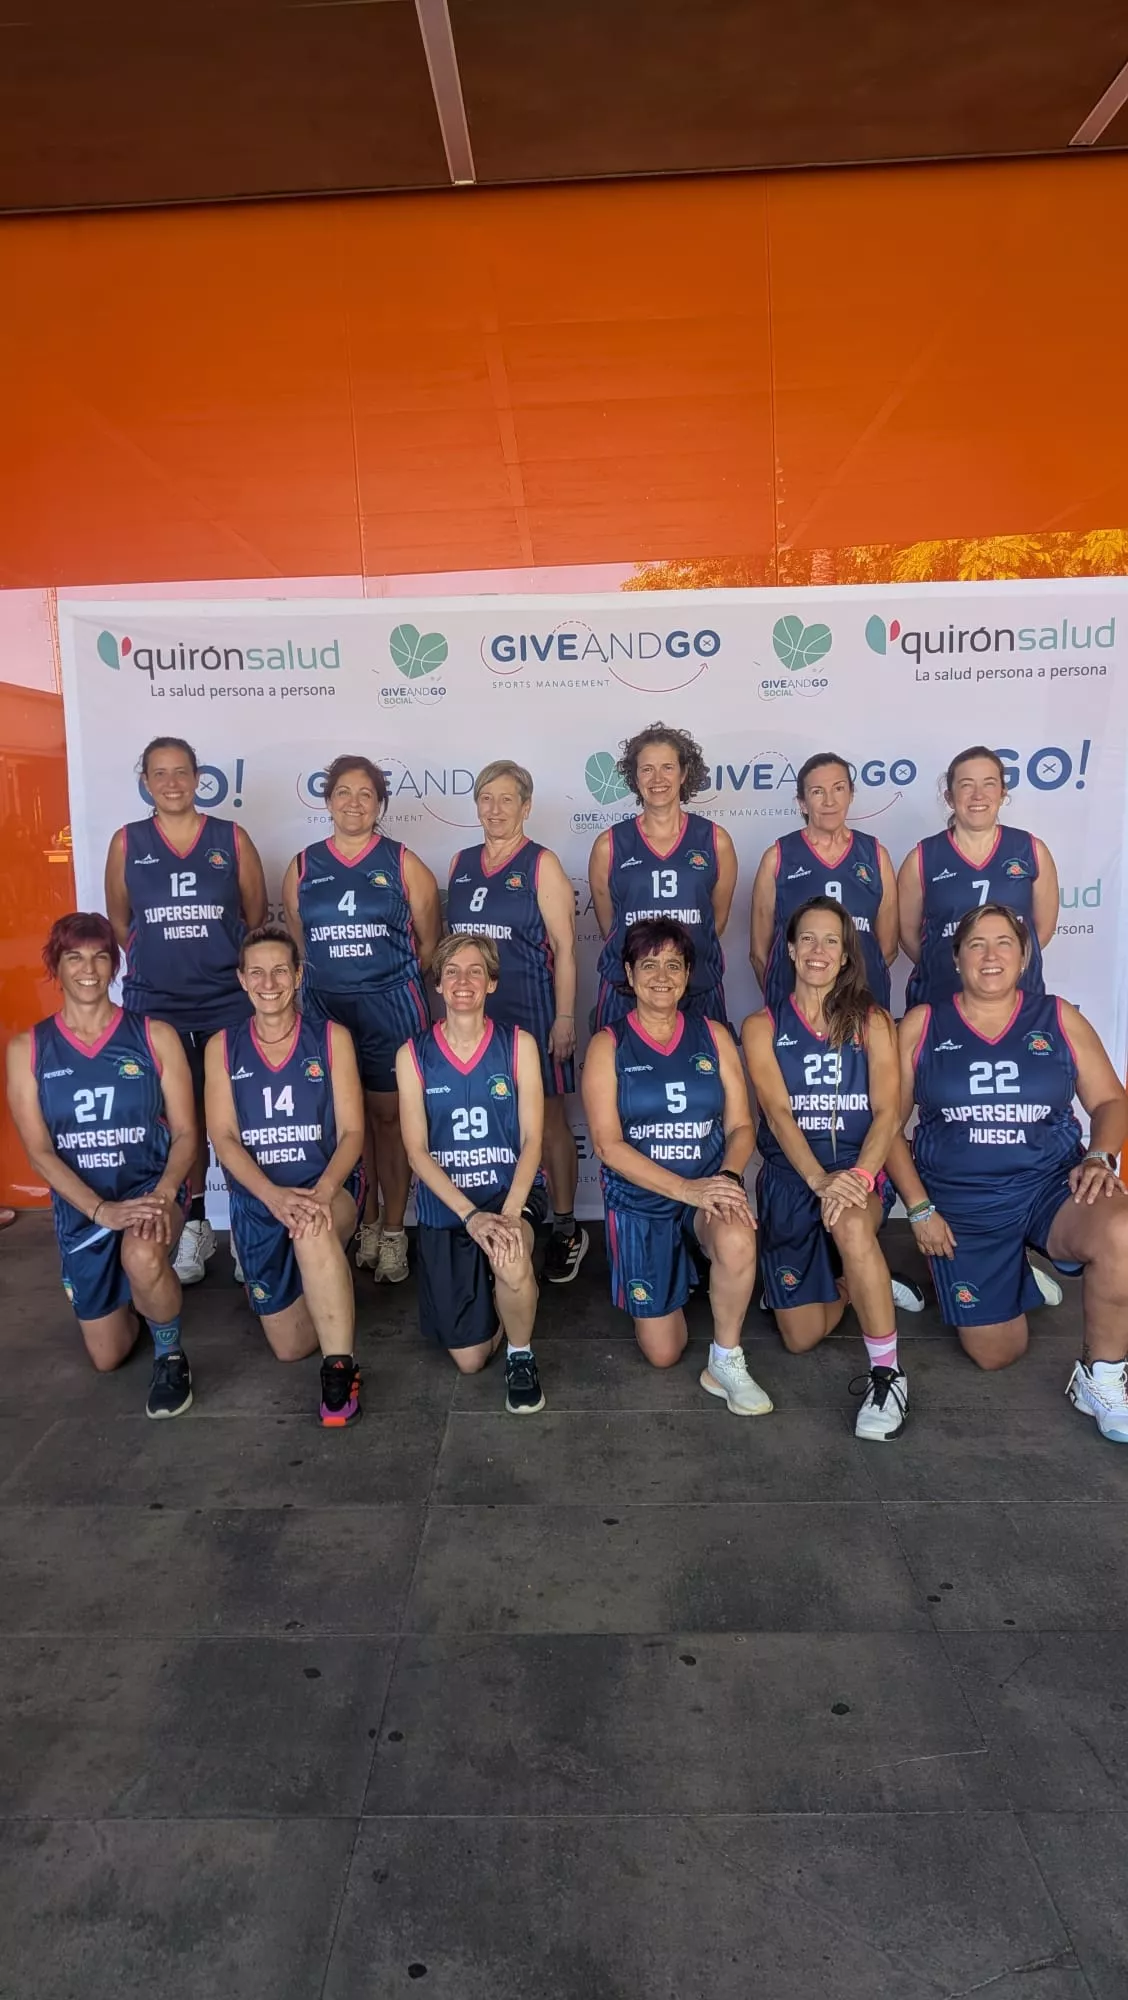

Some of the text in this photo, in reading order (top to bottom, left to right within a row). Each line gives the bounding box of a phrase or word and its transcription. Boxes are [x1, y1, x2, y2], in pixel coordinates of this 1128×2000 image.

[490, 629, 721, 662] GIVEANDGO
[901, 617, 1116, 664] quirónsalud
[133, 639, 340, 680] quirónsalud
[536, 679, 610, 688] MANAGEMENT
[915, 665, 1107, 683] La salud persona a persona
[151, 683, 335, 700] La salud persona a persona
[381, 687, 447, 696] GIVEANDGO
[761, 679, 828, 689] GIVEANDGO
[764, 689, 793, 697] SOCIAL
[992, 740, 1091, 791] GO!
[730, 808, 799, 817] MANAGEMEN
[170, 872, 197, 897] 12
[651, 869, 678, 898] 13
[825, 881, 842, 904] 9
[972, 879, 990, 905] 7
[338, 890, 357, 916] 4
[469, 887, 488, 912] 8
[144, 905, 224, 924] SUPERSENIOR
[163, 925, 209, 940] HUESCA
[310, 923, 390, 941] SUPERSENIOR
[329, 943, 373, 958] HUESCA
[804, 1053, 842, 1086] 23
[969, 1061, 1020, 1094] 22
[73, 1086, 115, 1123] 27
[262, 1085, 294, 1119] 14
[665, 1082, 687, 1114] 5
[789, 1094, 869, 1111] UPERSENIOR
[941, 1104, 1051, 1122] SUPERSENIOR
[451, 1106, 488, 1141] 29
[57, 1126, 146, 1149] SUPERSENIOR
[969, 1127, 1026, 1145] HUESCA
[77, 1150, 126, 1168] HUESCA
[256, 1147, 306, 1166] HUESCA
[650, 1144, 701, 1160] HUESCA
[451, 1169, 498, 1188] HUESCA
